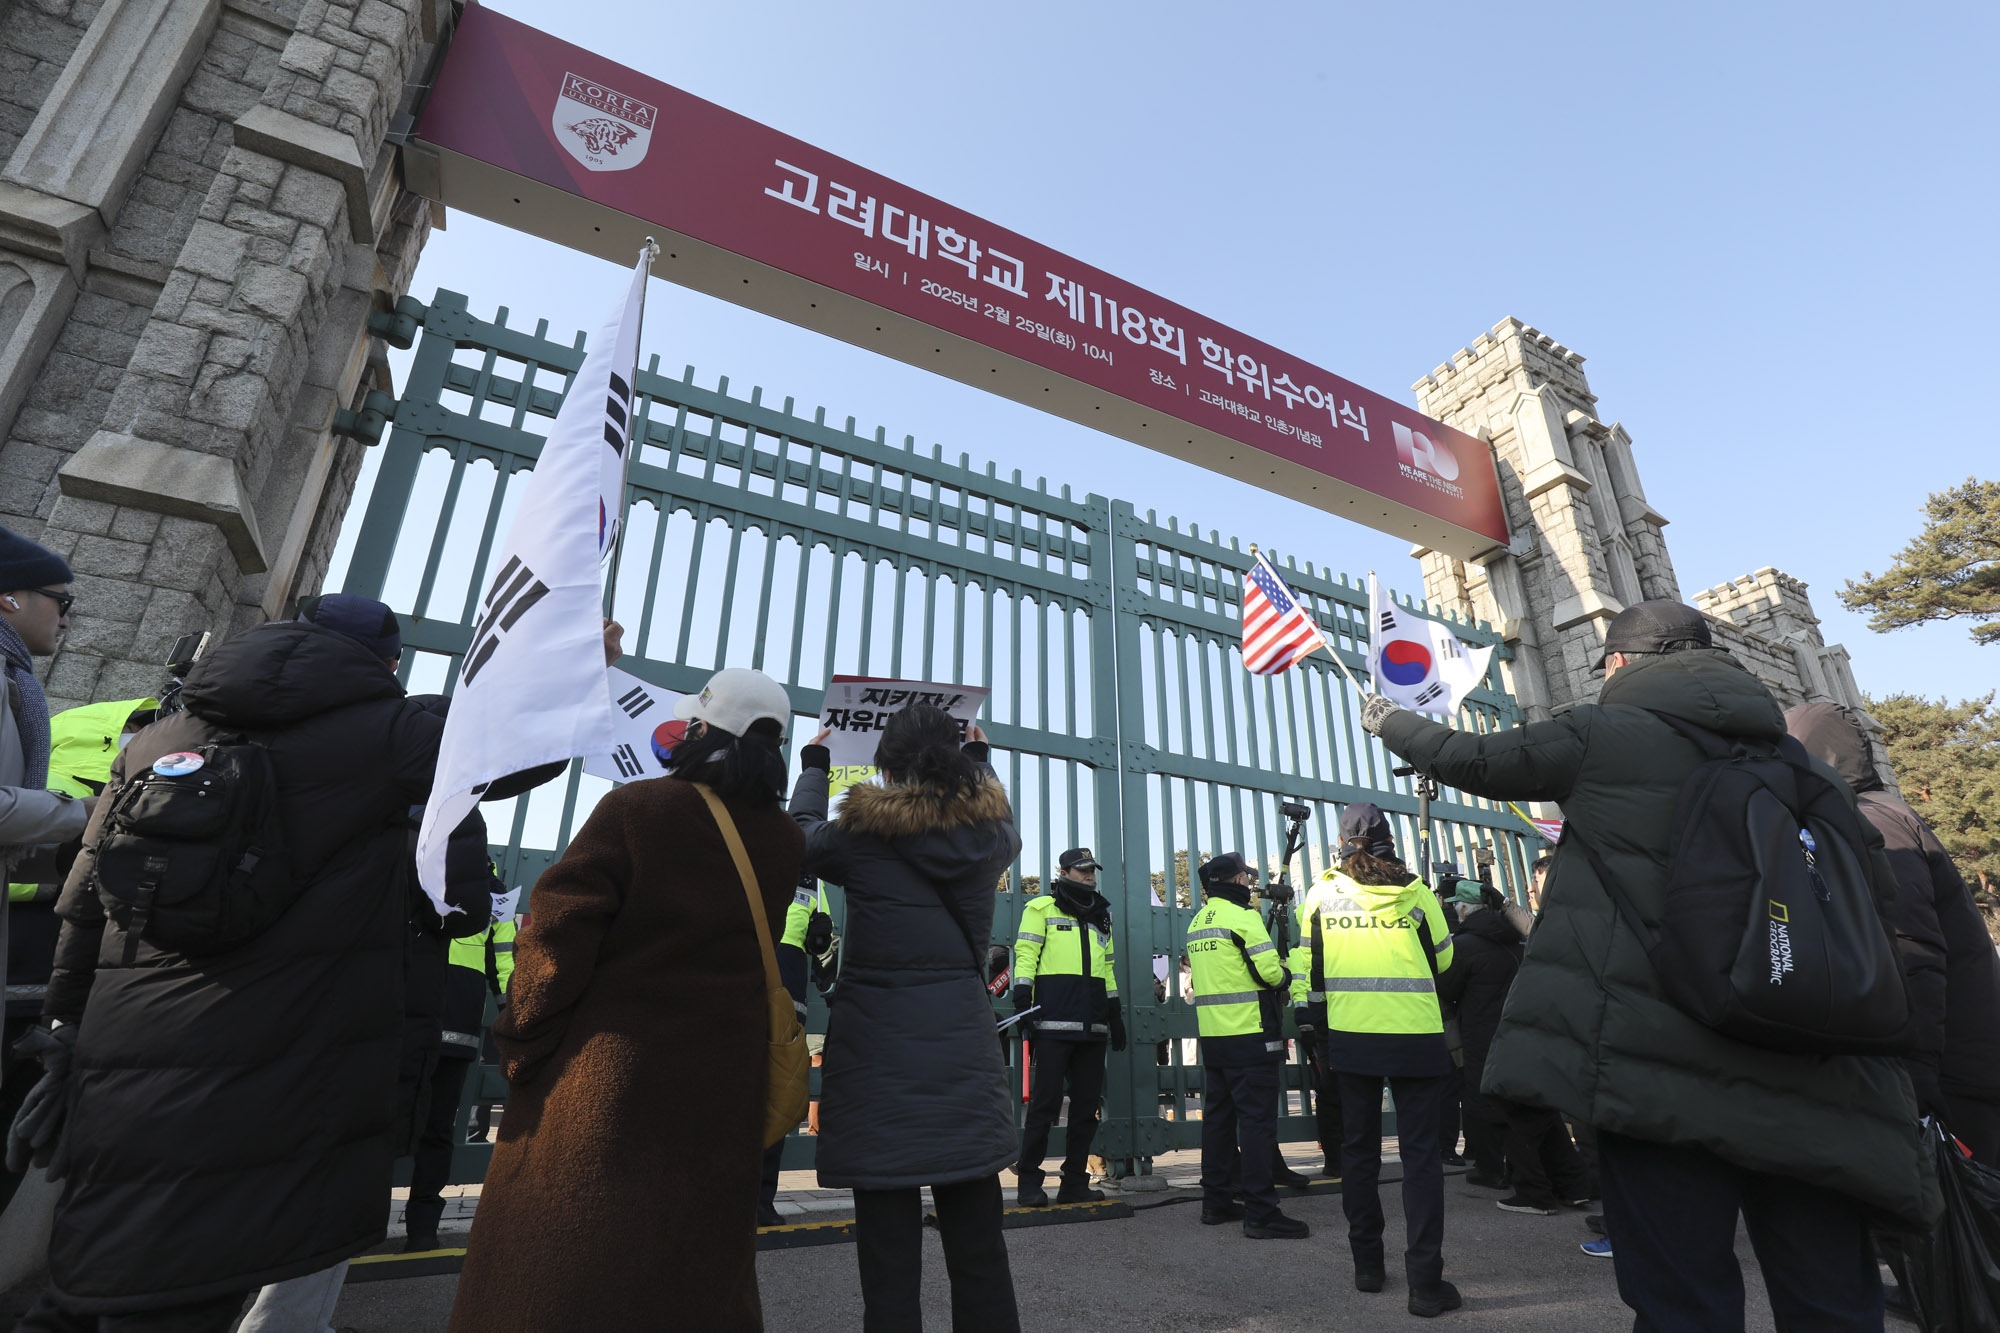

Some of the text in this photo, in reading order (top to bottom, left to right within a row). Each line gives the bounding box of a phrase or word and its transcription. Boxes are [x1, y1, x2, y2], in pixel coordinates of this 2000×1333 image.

[569, 90, 647, 125] UNIVERSITY
[571, 79, 649, 119] KOREA
[585, 154, 603, 165] 1905
[764, 158, 1370, 442] 고려대학교 제118회 학위수여식
[853, 251, 890, 279] 일시
[920, 278, 978, 313] 2025년
[983, 303, 1010, 326] 2월
[1015, 315, 1076, 351] 25일(화)
[1082, 341, 1114, 367] 10시
[1149, 367, 1177, 391] 장소
[1199, 388, 1262, 424] 고려대학교
[1264, 414, 1323, 449] 인촌기념관
[1398, 461, 1463, 495] WE ARE THE NEXT
[1401, 471, 1423, 484] KOREA
[860, 687, 963, 712] 지키자!
[1326, 915, 1411, 930] POLICE
[1768, 920, 1783, 986] GEOGRAPHIC
[1777, 923, 1794, 973] NATIONAL
